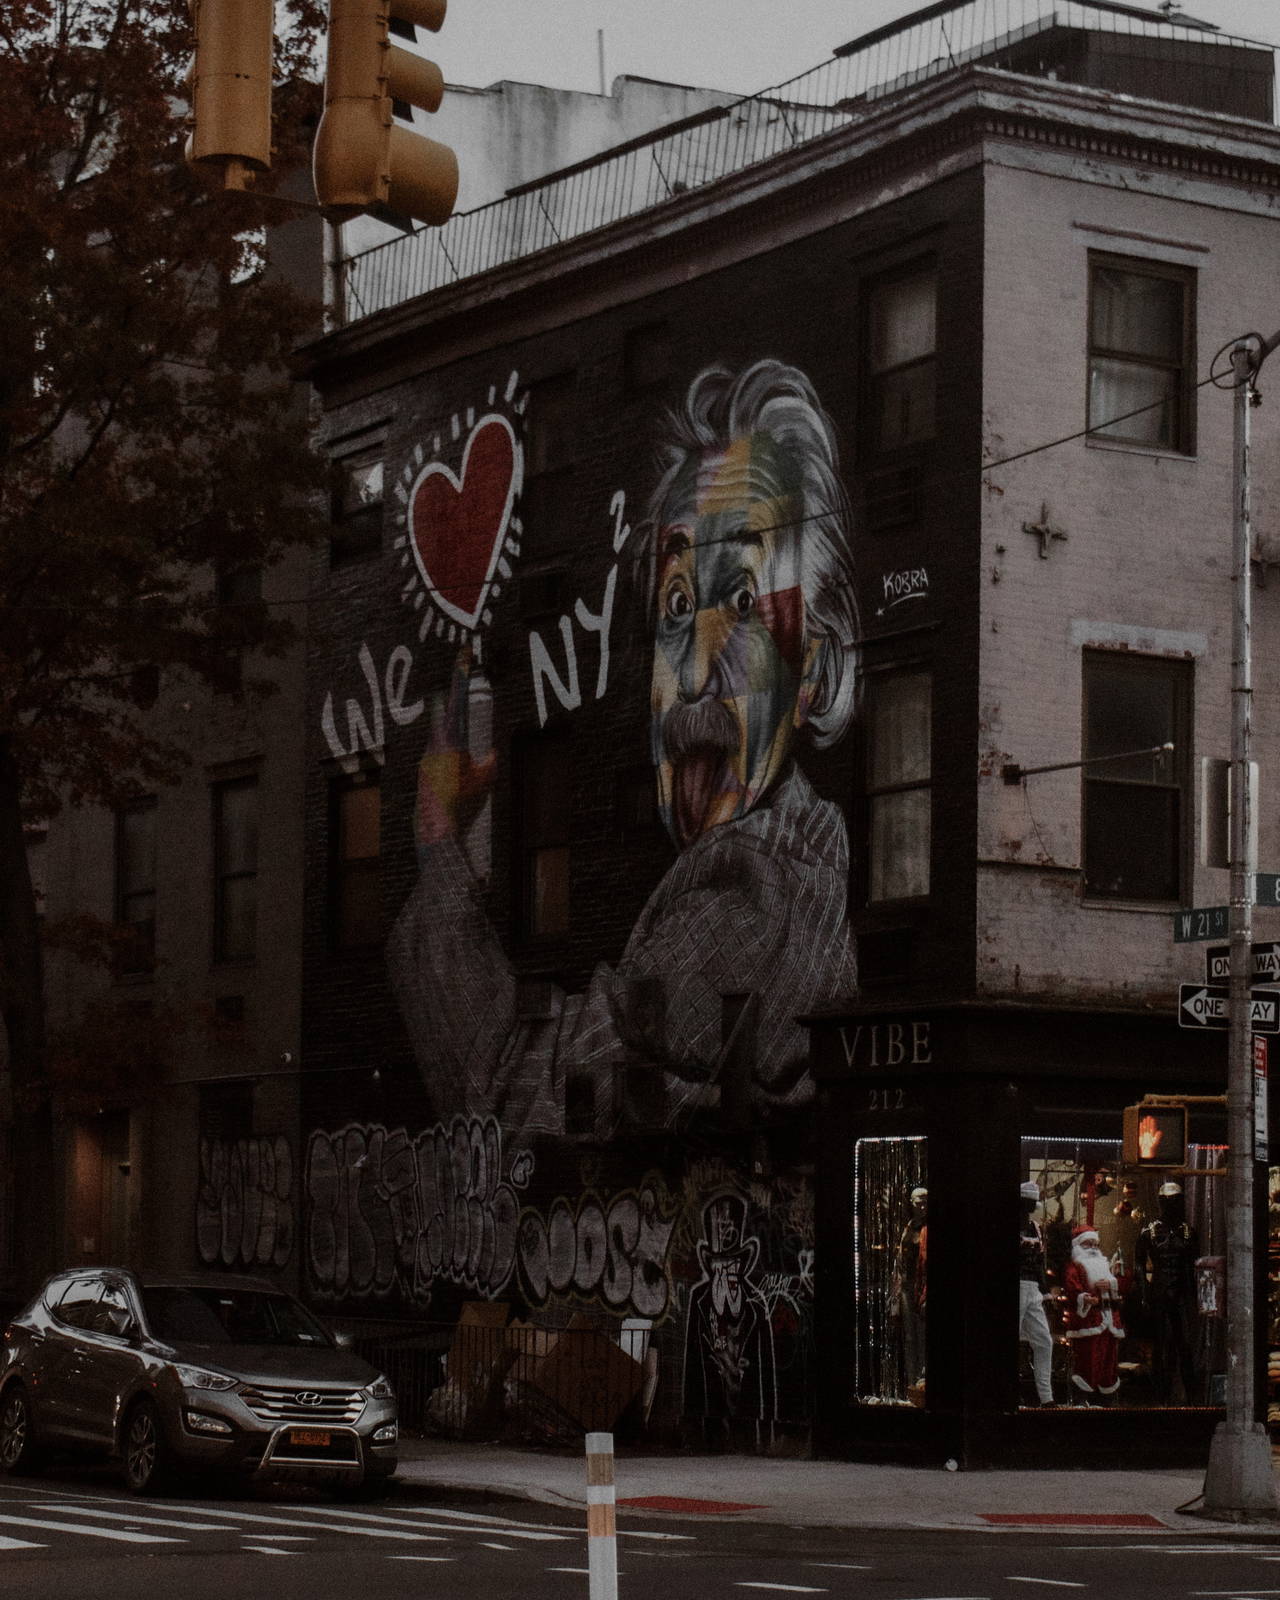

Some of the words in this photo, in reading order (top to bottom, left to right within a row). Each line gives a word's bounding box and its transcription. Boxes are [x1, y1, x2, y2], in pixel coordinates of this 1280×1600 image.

[882, 567, 929, 600] KOBRA
[320, 640, 425, 774] We
[1181, 914, 1192, 938] W
[1197, 913, 1210, 937] 21
[1214, 959, 1230, 975] ON
[1193, 998, 1224, 1016] ONE
[1251, 1002, 1271, 1019] AY
[836, 1021, 933, 1068] VIBE
[868, 1088, 905, 1111] 212
